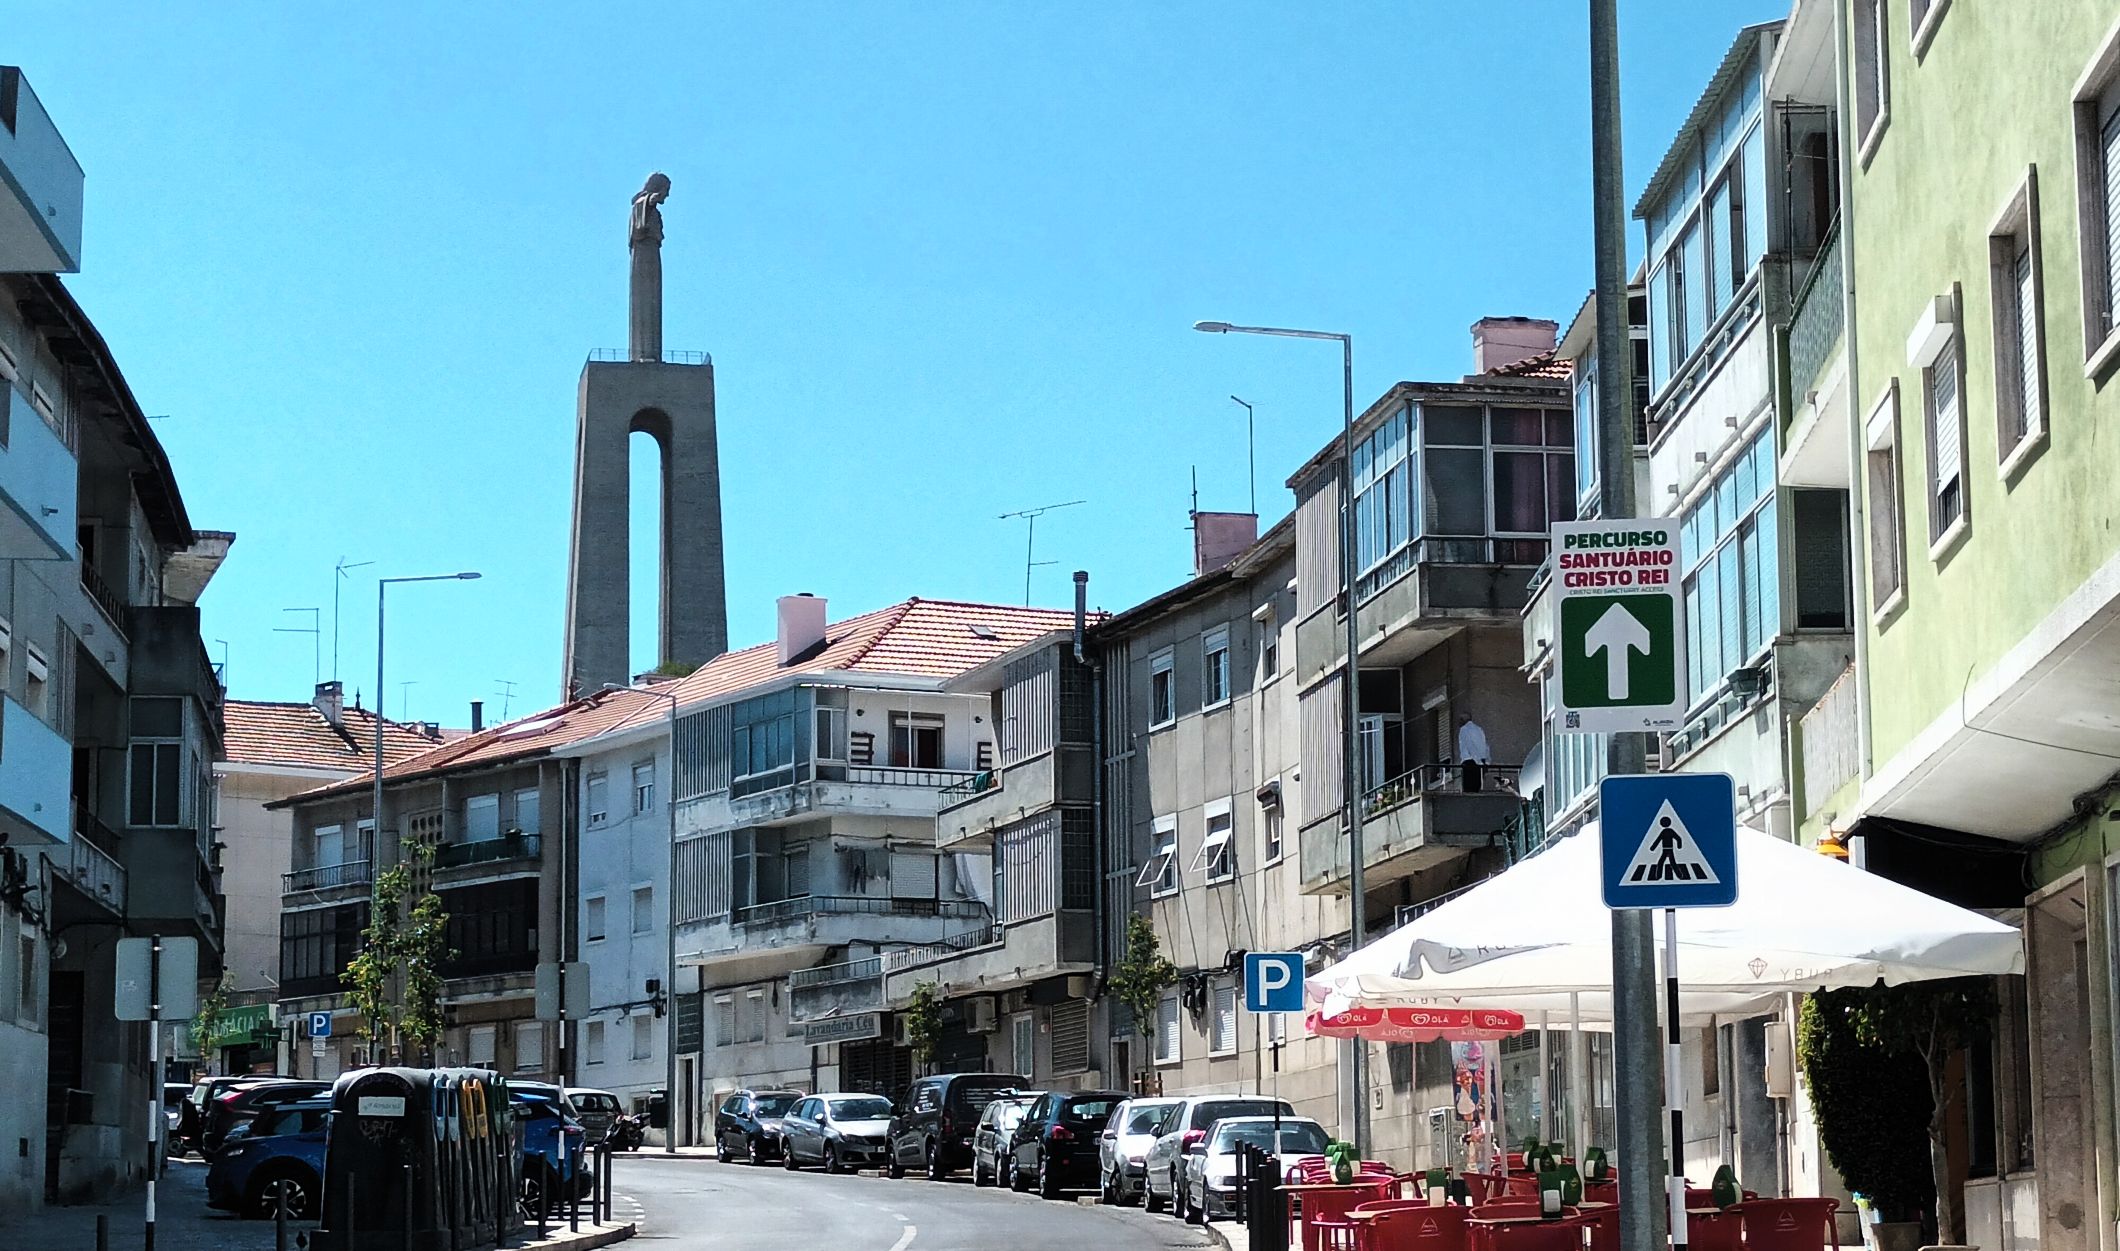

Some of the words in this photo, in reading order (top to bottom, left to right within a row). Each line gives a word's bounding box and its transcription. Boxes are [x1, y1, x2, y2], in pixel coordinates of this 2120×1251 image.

[1564, 530, 1668, 549] PERCURSO
[1559, 547, 1673, 569] SANTUÁRIO
[1564, 570, 1633, 588] CRISTO
[1638, 569, 1669, 585] REI
[1258, 959, 1291, 1006] P
[313, 1014, 326, 1034] P
